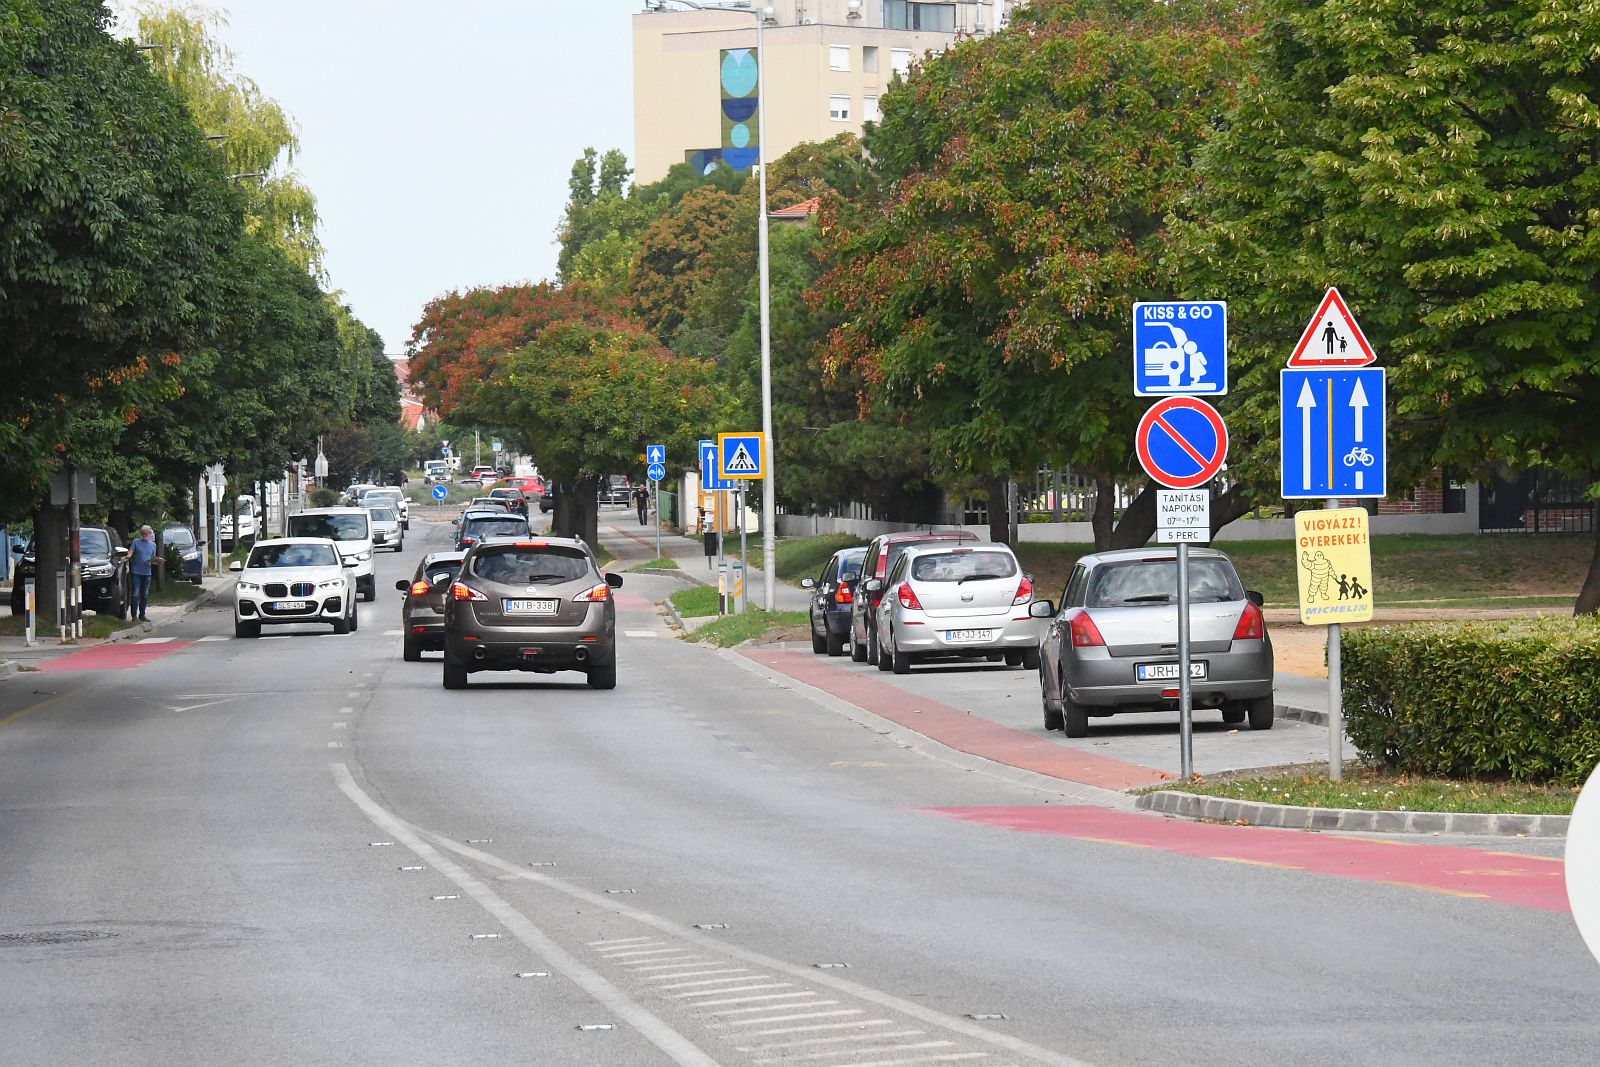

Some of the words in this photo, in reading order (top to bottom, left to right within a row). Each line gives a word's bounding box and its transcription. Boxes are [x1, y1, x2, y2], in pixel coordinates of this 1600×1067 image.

[1144, 306, 1175, 320] KISS
[1177, 306, 1187, 319] &
[1189, 305, 1213, 319] GO
[1162, 492, 1204, 502] TANÍTÁSI
[1162, 504, 1205, 513] NAPOKON
[1168, 531, 1174, 540] 5
[1176, 531, 1199, 540] PERC
[513, 601, 553, 610] NIB-338
[1305, 604, 1368, 615] MICHELIN
[1148, 664, 1203, 678] JRH-2
